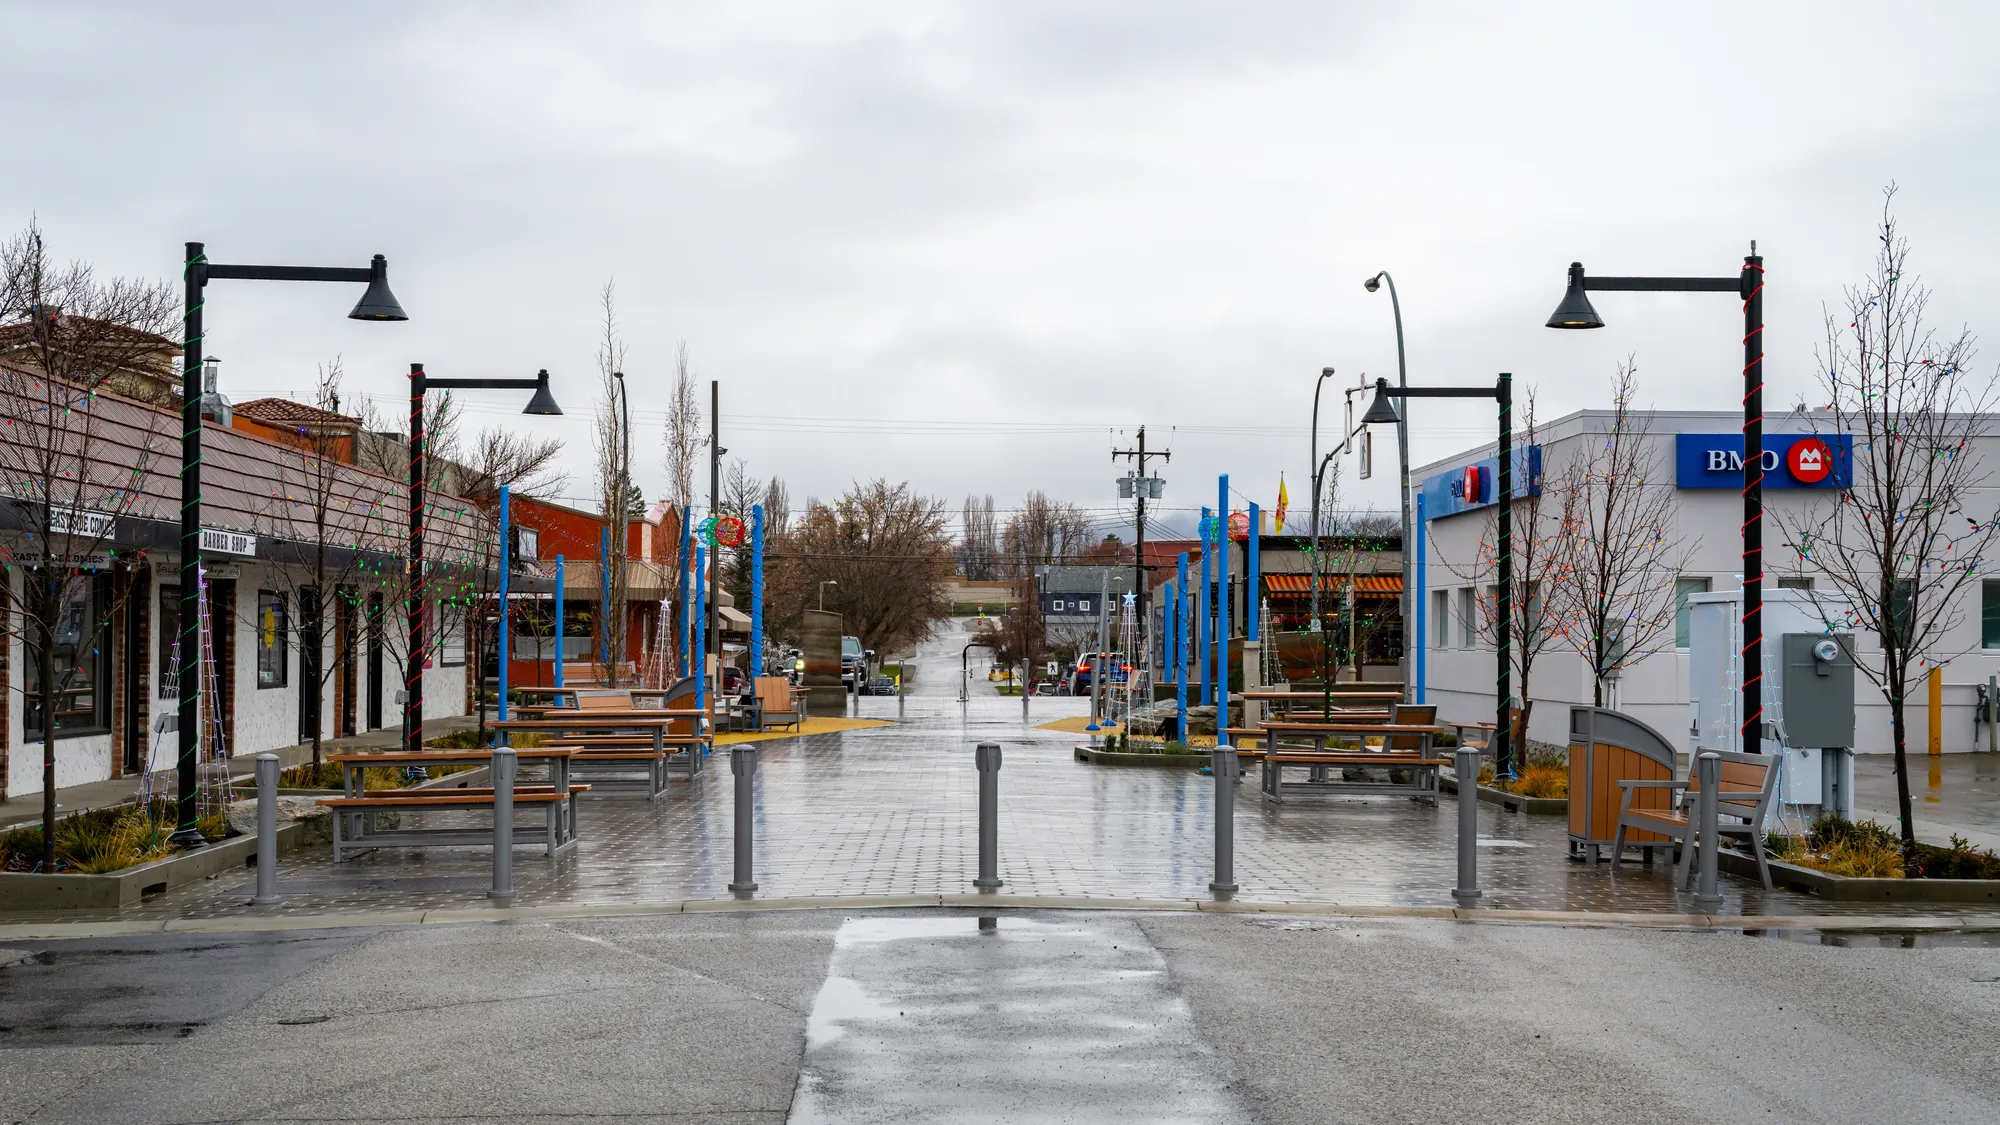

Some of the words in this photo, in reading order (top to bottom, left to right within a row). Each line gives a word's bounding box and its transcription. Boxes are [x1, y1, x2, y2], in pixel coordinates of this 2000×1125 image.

[1707, 450, 1780, 471] BMO
[203, 531, 228, 551] BARBER
[231, 535, 248, 553] SHOP
